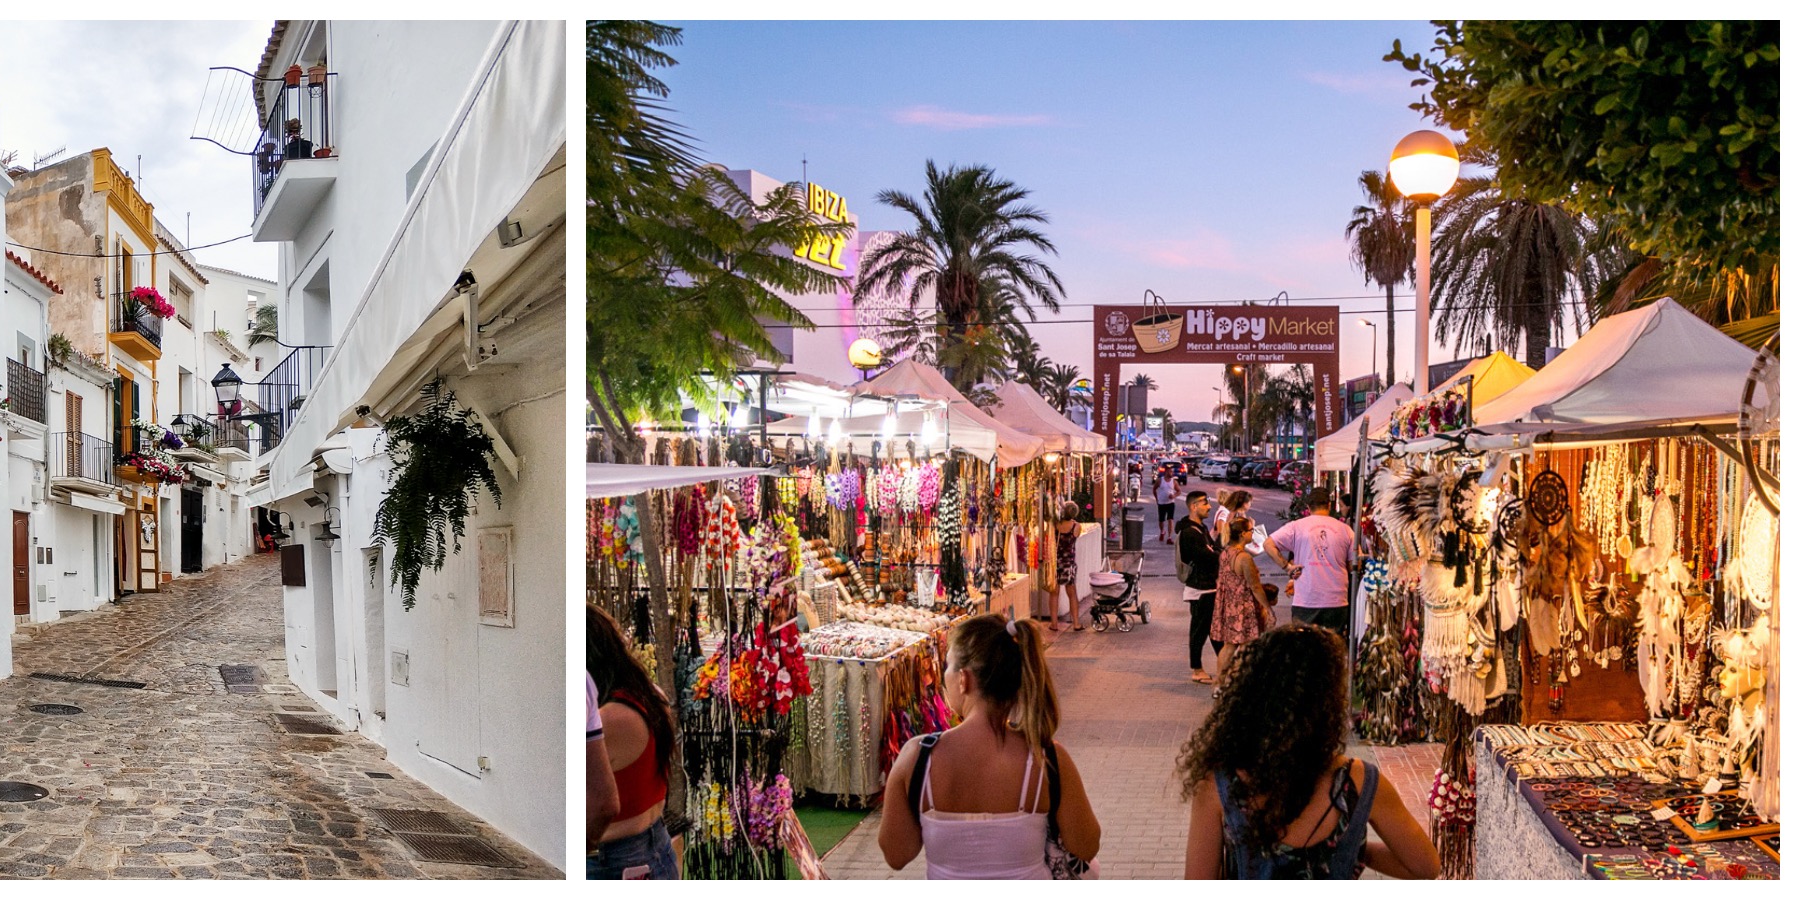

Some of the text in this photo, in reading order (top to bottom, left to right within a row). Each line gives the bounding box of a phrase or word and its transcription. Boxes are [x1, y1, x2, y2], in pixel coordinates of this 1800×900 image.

[808, 182, 849, 224] IBIZA
[1186, 308, 1335, 341] Hippy Market
[1116, 343, 1137, 351] Josep
[1186, 342, 1335, 350] Mercat artesanal Mercadillo artesanal
[1236, 353, 1285, 361] Craft market
